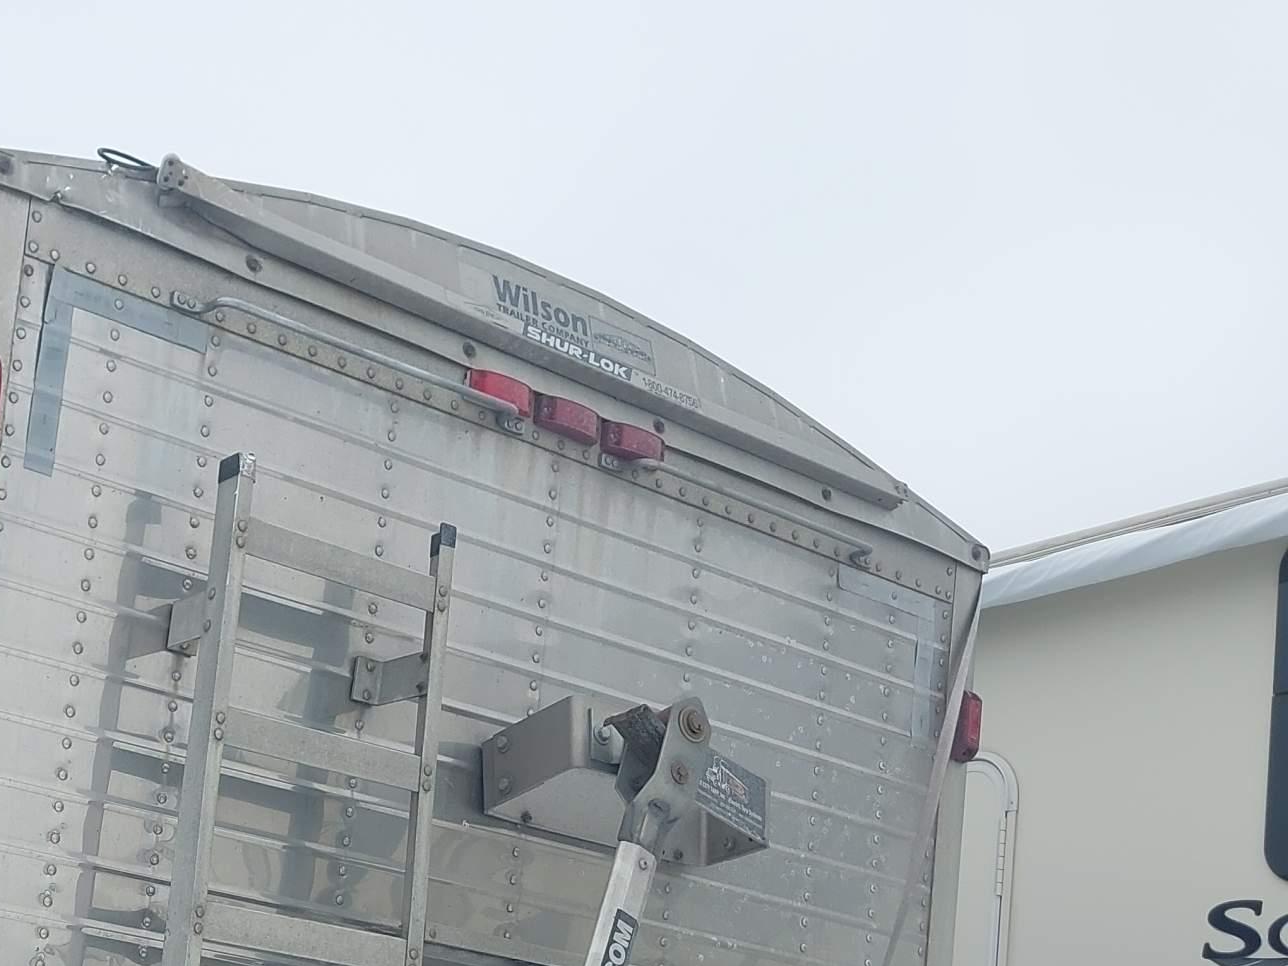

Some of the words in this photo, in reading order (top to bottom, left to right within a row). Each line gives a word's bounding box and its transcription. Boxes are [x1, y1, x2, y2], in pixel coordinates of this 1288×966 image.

[492, 275, 588, 337] Wilson
[496, 303, 539, 329] TRAILER
[541, 322, 589, 349] COMPANY
[526, 325, 628, 379] SHUR-LOK
